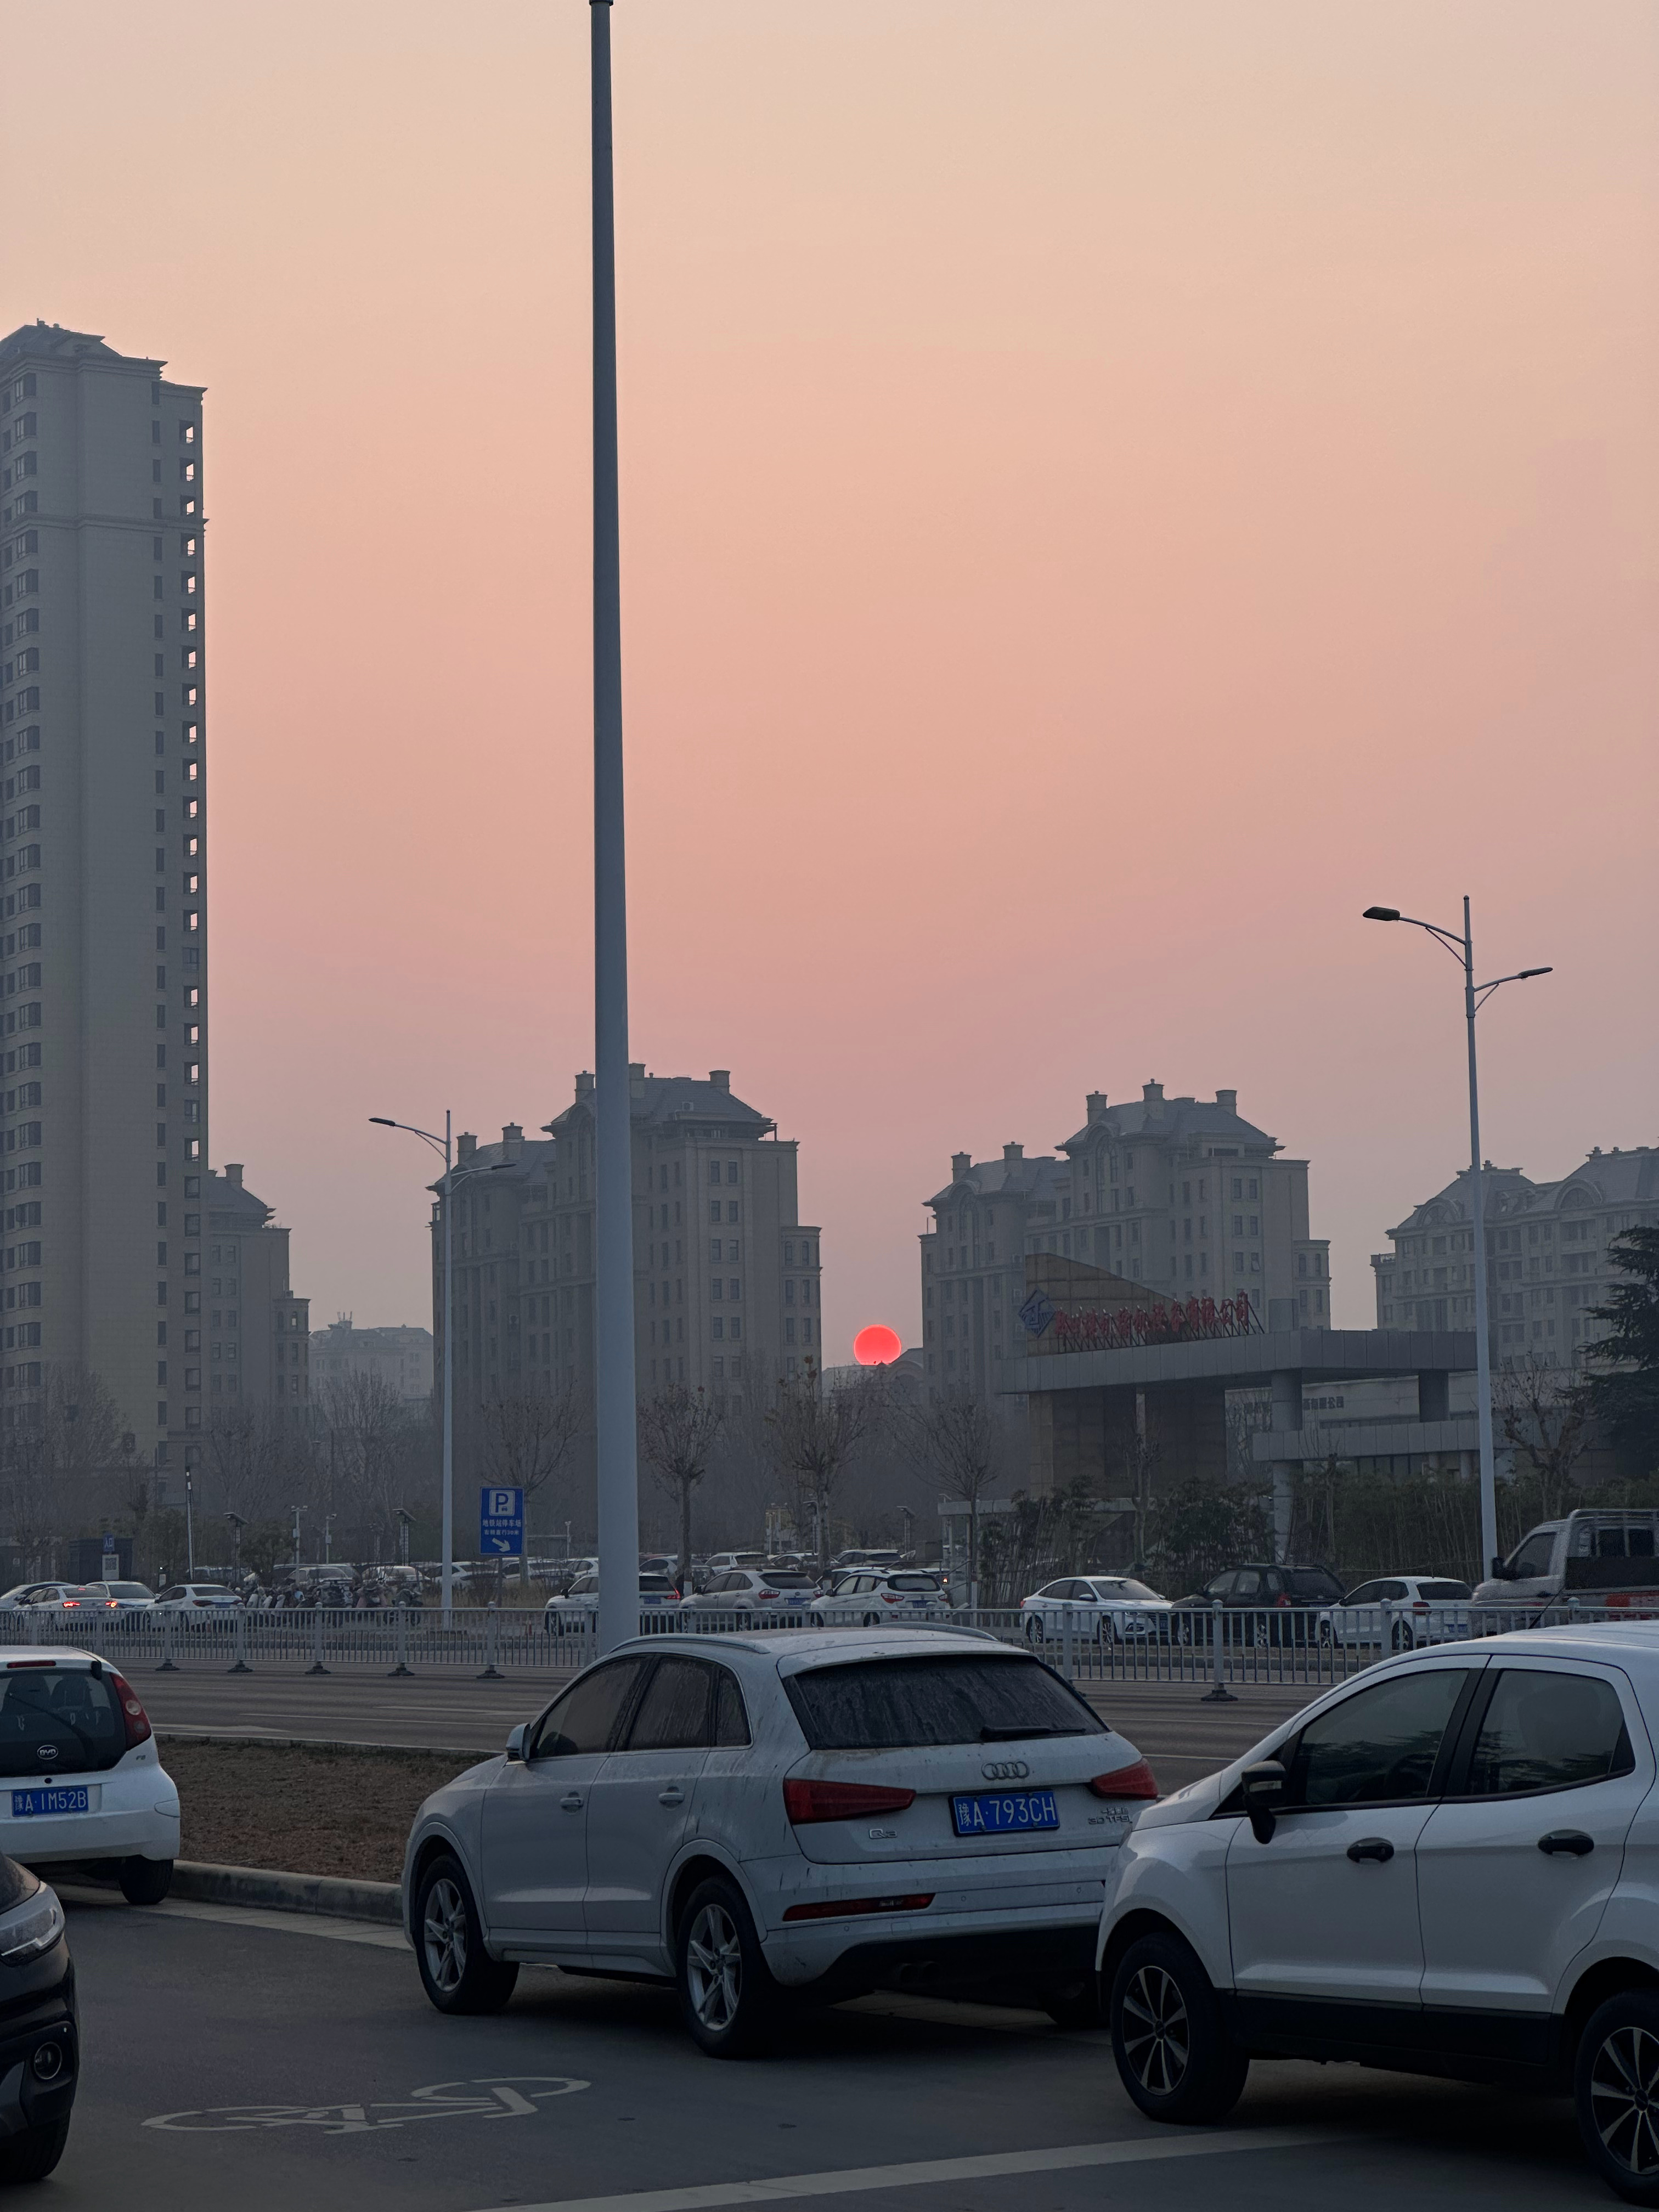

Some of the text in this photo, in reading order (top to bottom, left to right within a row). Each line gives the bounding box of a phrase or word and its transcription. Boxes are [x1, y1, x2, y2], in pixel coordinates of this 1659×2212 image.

[495, 1492, 509, 1513] P
[482, 1518, 522, 1528] 地铁站停车场
[104, 1538, 114, 1548] 入口
[869, 1829, 898, 1839] Q3
